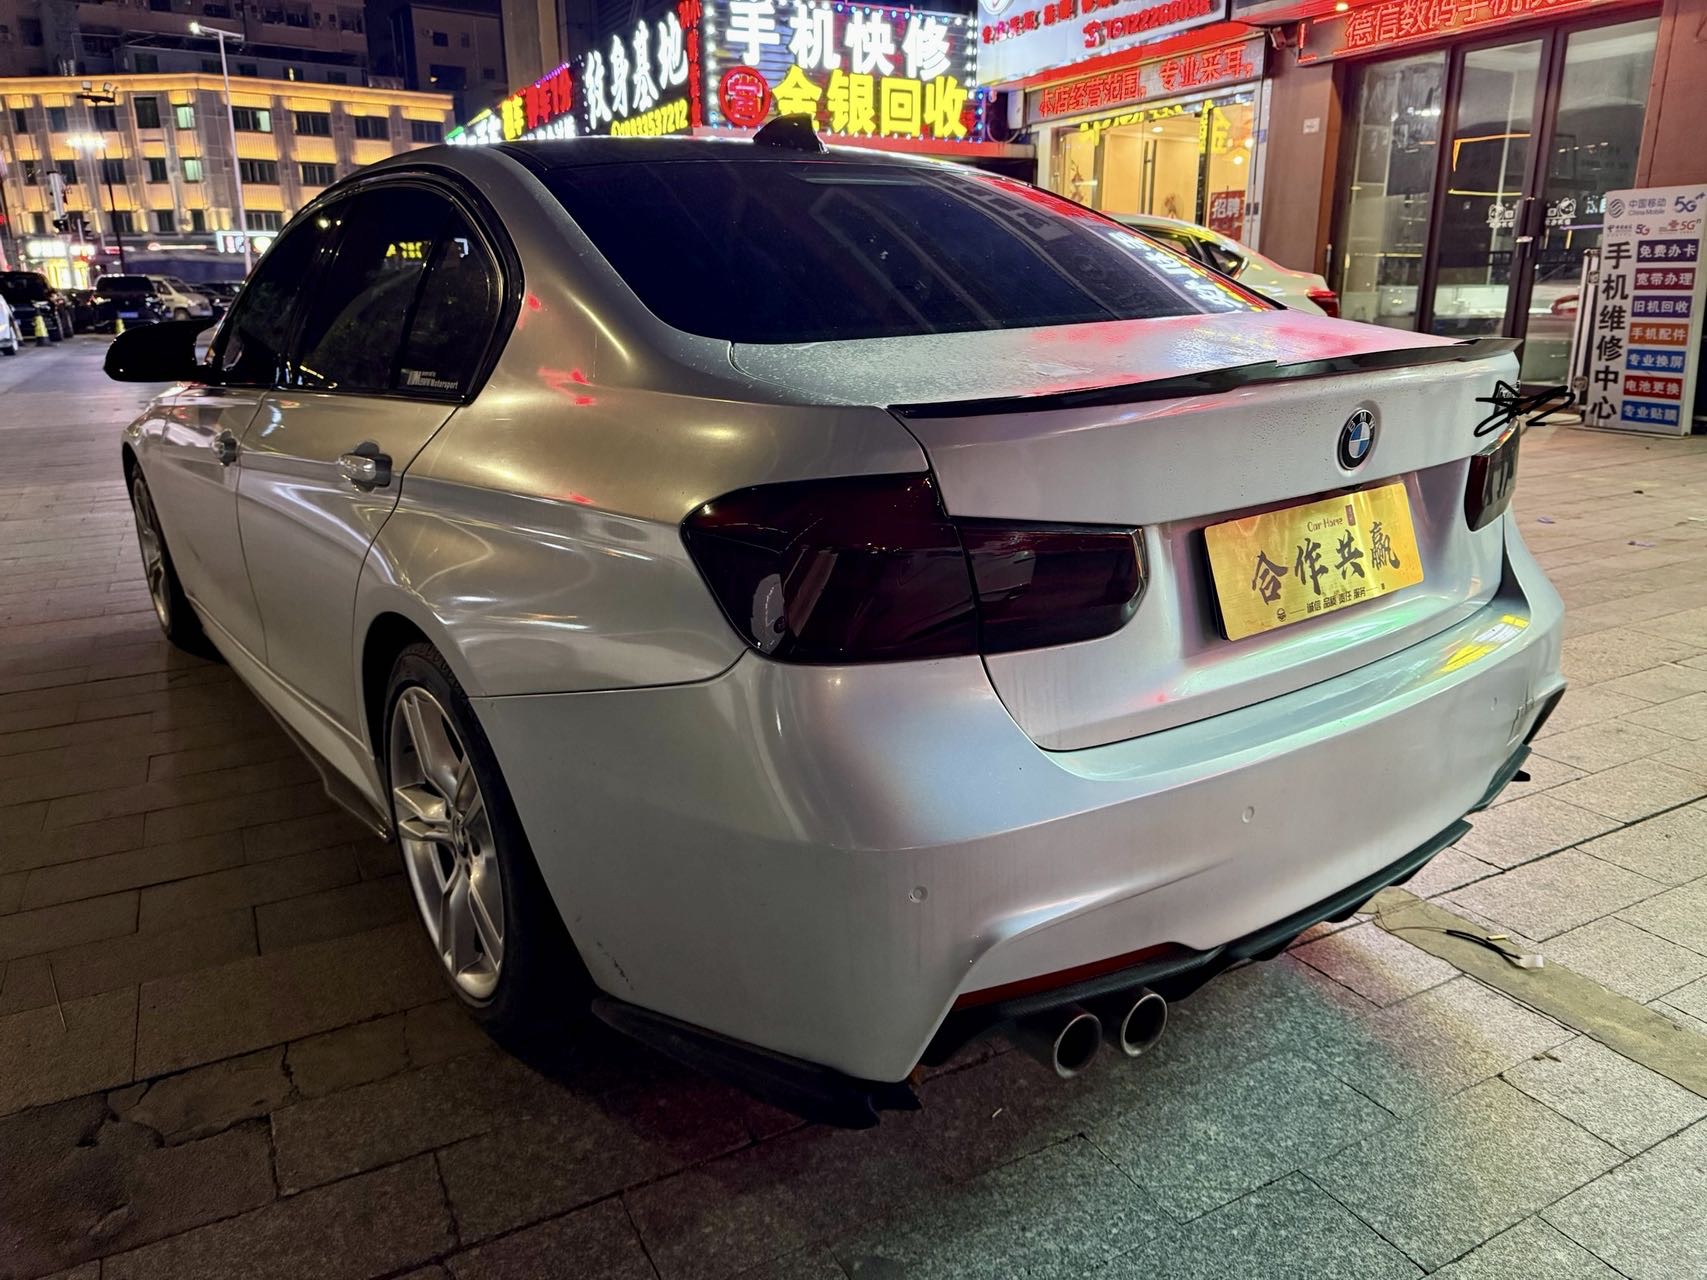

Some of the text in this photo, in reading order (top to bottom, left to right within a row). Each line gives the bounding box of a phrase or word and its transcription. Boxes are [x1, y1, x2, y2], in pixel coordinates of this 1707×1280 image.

[1347, 0, 1542, 47] 德信数码手
[726, 1, 951, 81] 手机快修
[586, 12, 688, 130] 纹身基地
[772, 65, 968, 138] 金银回收
[1212, 198, 1239, 218] 招聘
[1628, 198, 1667, 209] 中国移动
[1639, 244, 1697, 258] 免费办卡
[1636, 272, 1693, 286] 宽带办理
[1633, 300, 1689, 313] 旧机回收
[1590, 241, 1632, 420] 手机维修中心
[1631, 327, 1686, 341] 手机配件
[1628, 353, 1683, 369] 专业换屏
[1625, 380, 1680, 396] 电池更换
[1623, 404, 1678, 422] 专业贴膜
[1307, 517, 1344, 532] Car Home
[1252, 521, 1400, 605] 合作共赢
[1306, 599, 1322, 613] 诚信
